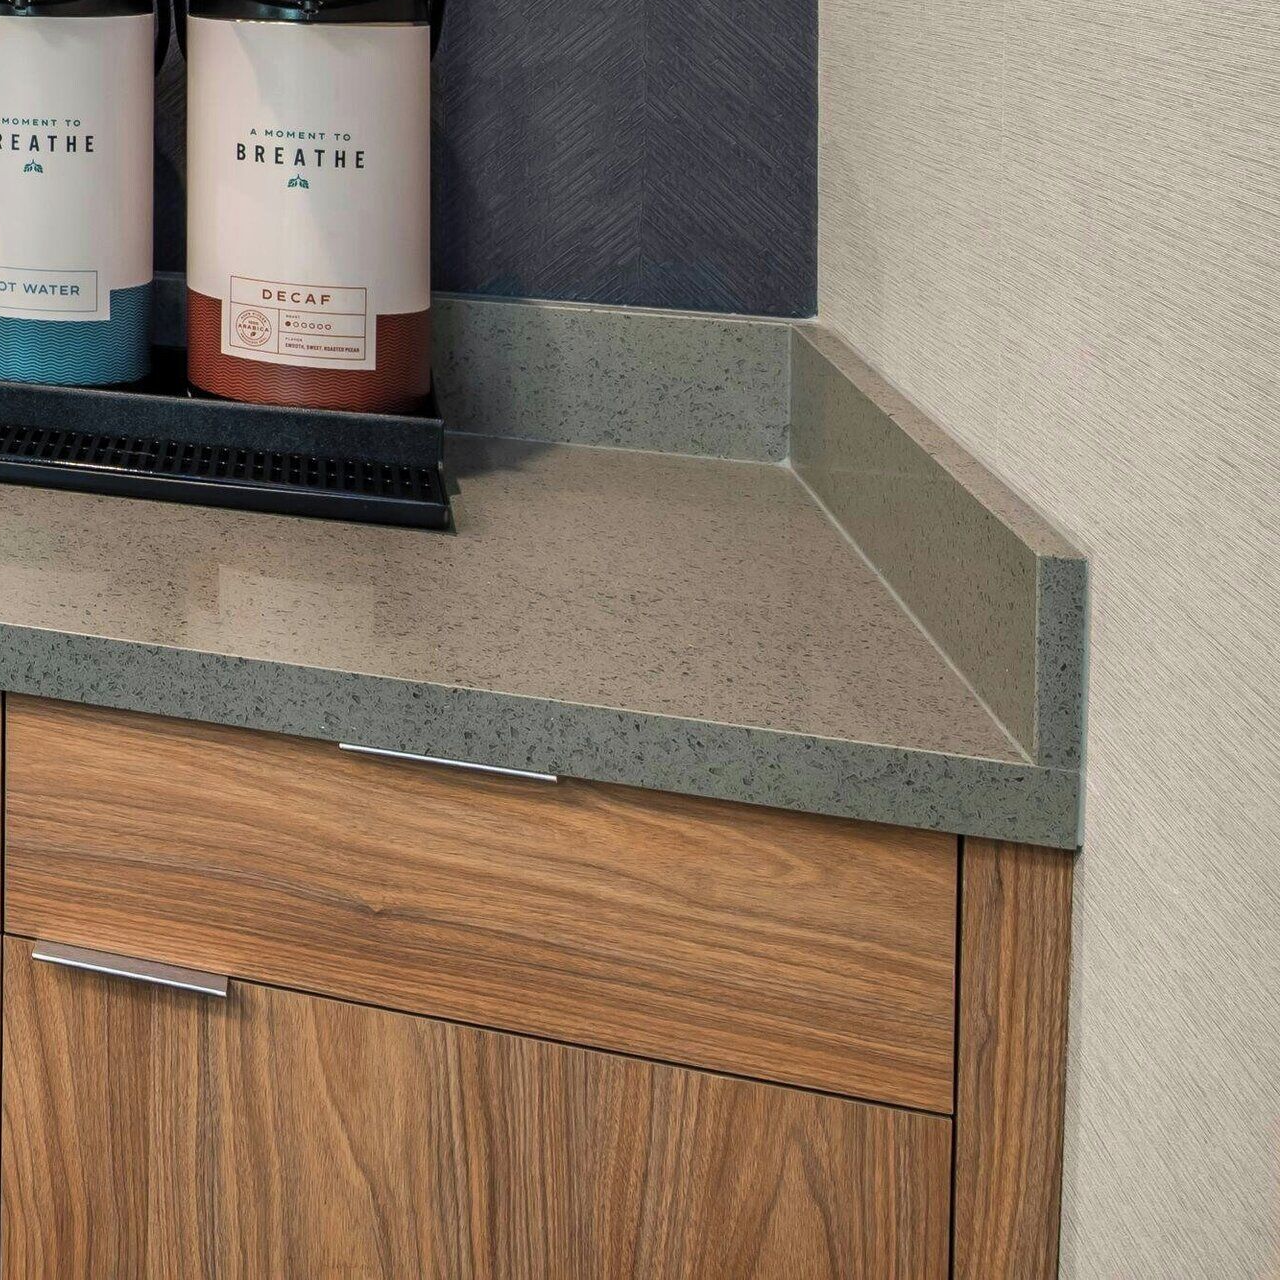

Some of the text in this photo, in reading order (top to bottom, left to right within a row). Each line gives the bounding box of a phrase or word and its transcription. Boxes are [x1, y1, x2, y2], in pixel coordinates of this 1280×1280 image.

[2, 117, 57, 126] MOMENT
[65, 119, 81, 127] TO
[264, 129, 325, 140] MOMENT
[334, 133, 351, 141] TO
[237, 143, 365, 168] BREATHE
[23, 282, 80, 296] WATER
[262, 288, 331, 305] DECAF
[238, 323, 269, 332] ARABICA
